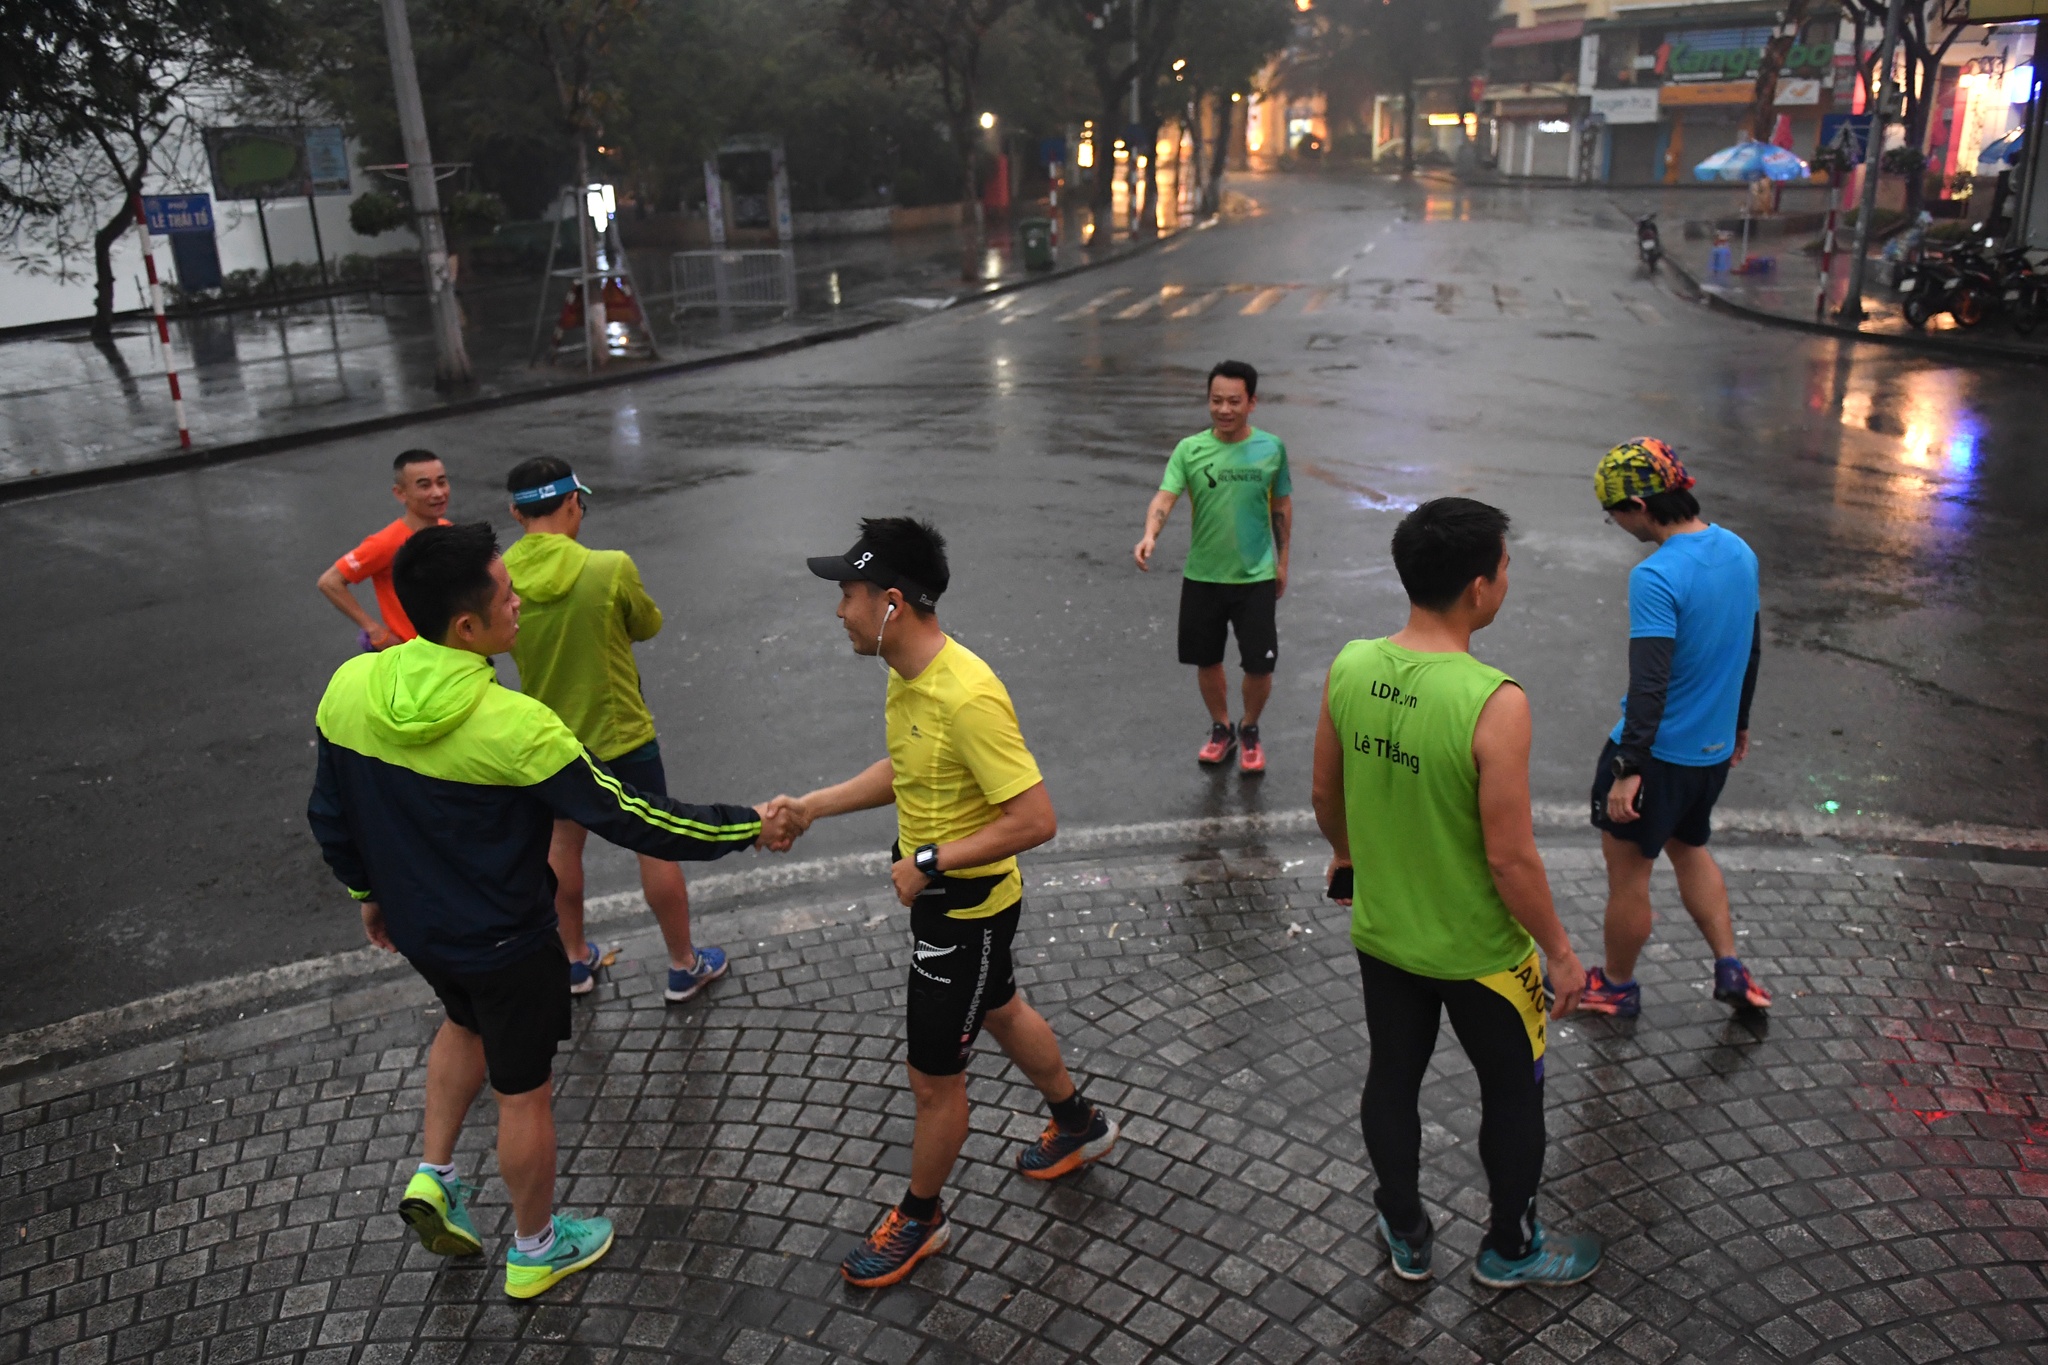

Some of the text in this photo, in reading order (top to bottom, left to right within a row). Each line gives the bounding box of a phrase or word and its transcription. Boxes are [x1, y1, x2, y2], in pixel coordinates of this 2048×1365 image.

[1668, 42, 1834, 79] Kangaoo
[1354, 731, 1420, 775] Lê Thắng
[917, 967, 952, 984] ZEALAND
[963, 928, 992, 1032] COMPRESSPORT
